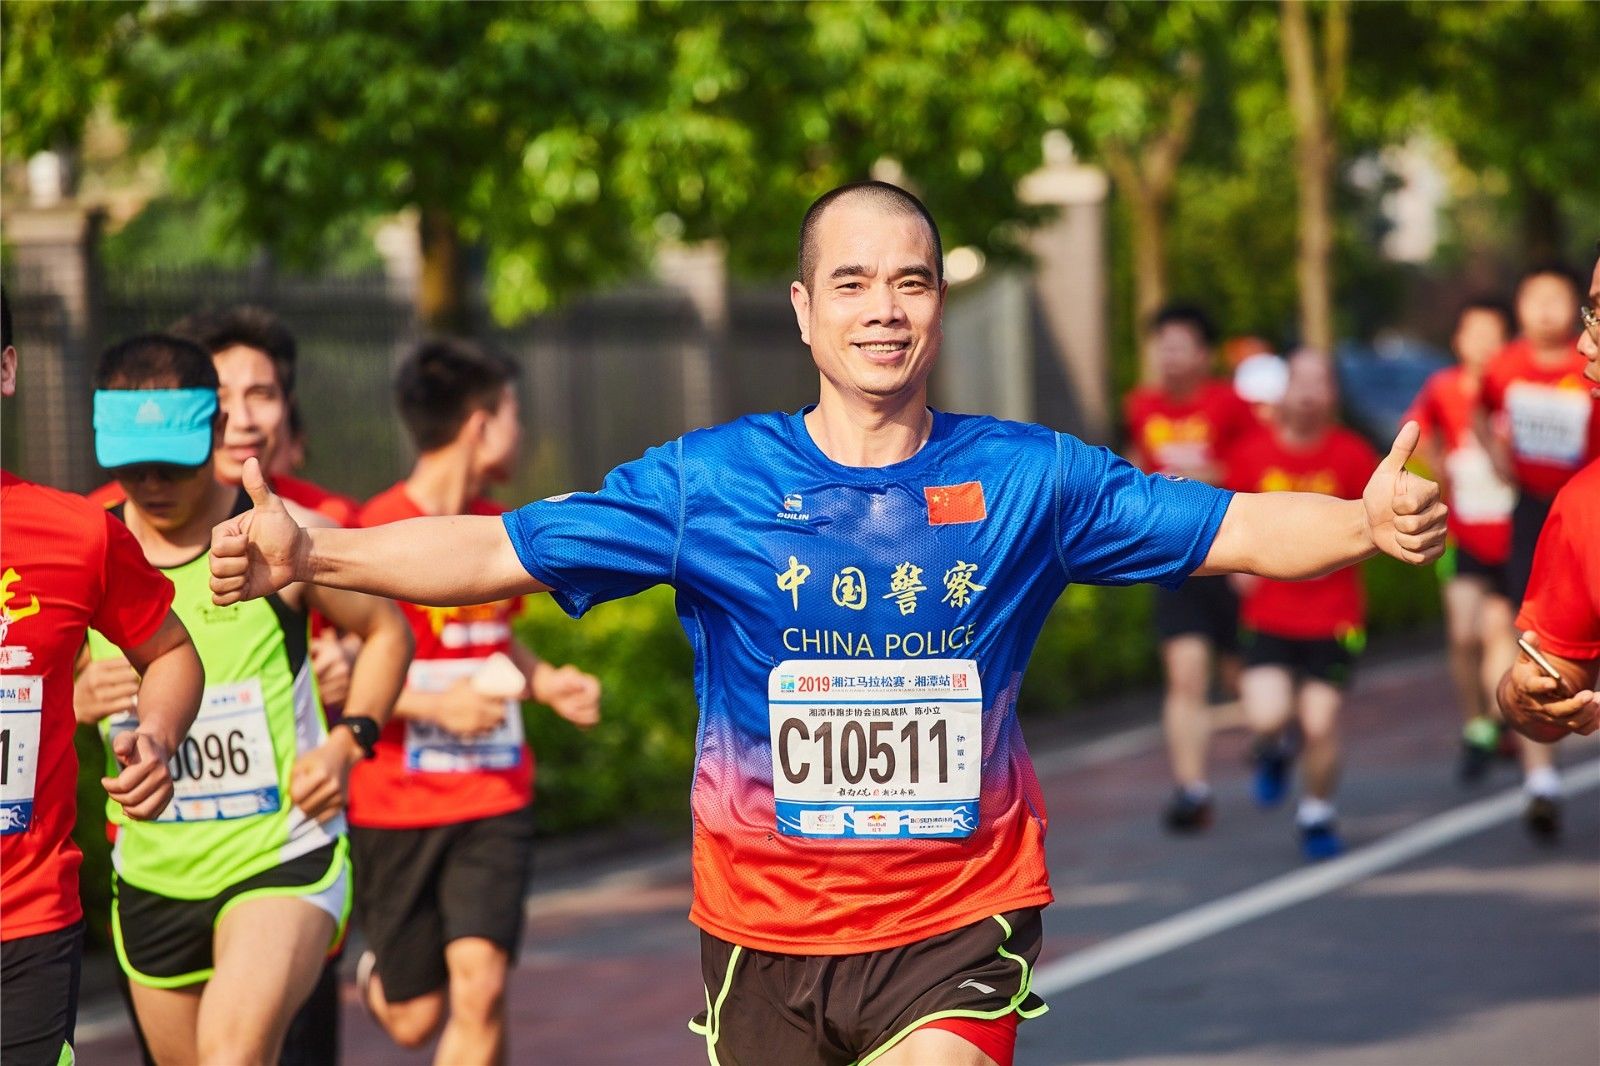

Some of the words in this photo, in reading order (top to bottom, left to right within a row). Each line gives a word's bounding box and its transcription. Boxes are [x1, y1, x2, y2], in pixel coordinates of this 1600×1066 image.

[776, 512, 810, 521] GUILIN
[775, 555, 987, 616] 中国警察
[782, 627, 875, 658] CHINA
[884, 622, 977, 658] POLICE
[798, 675, 831, 693] 2019
[914, 706, 941, 716] 陈小立
[778, 717, 948, 785] C10511
